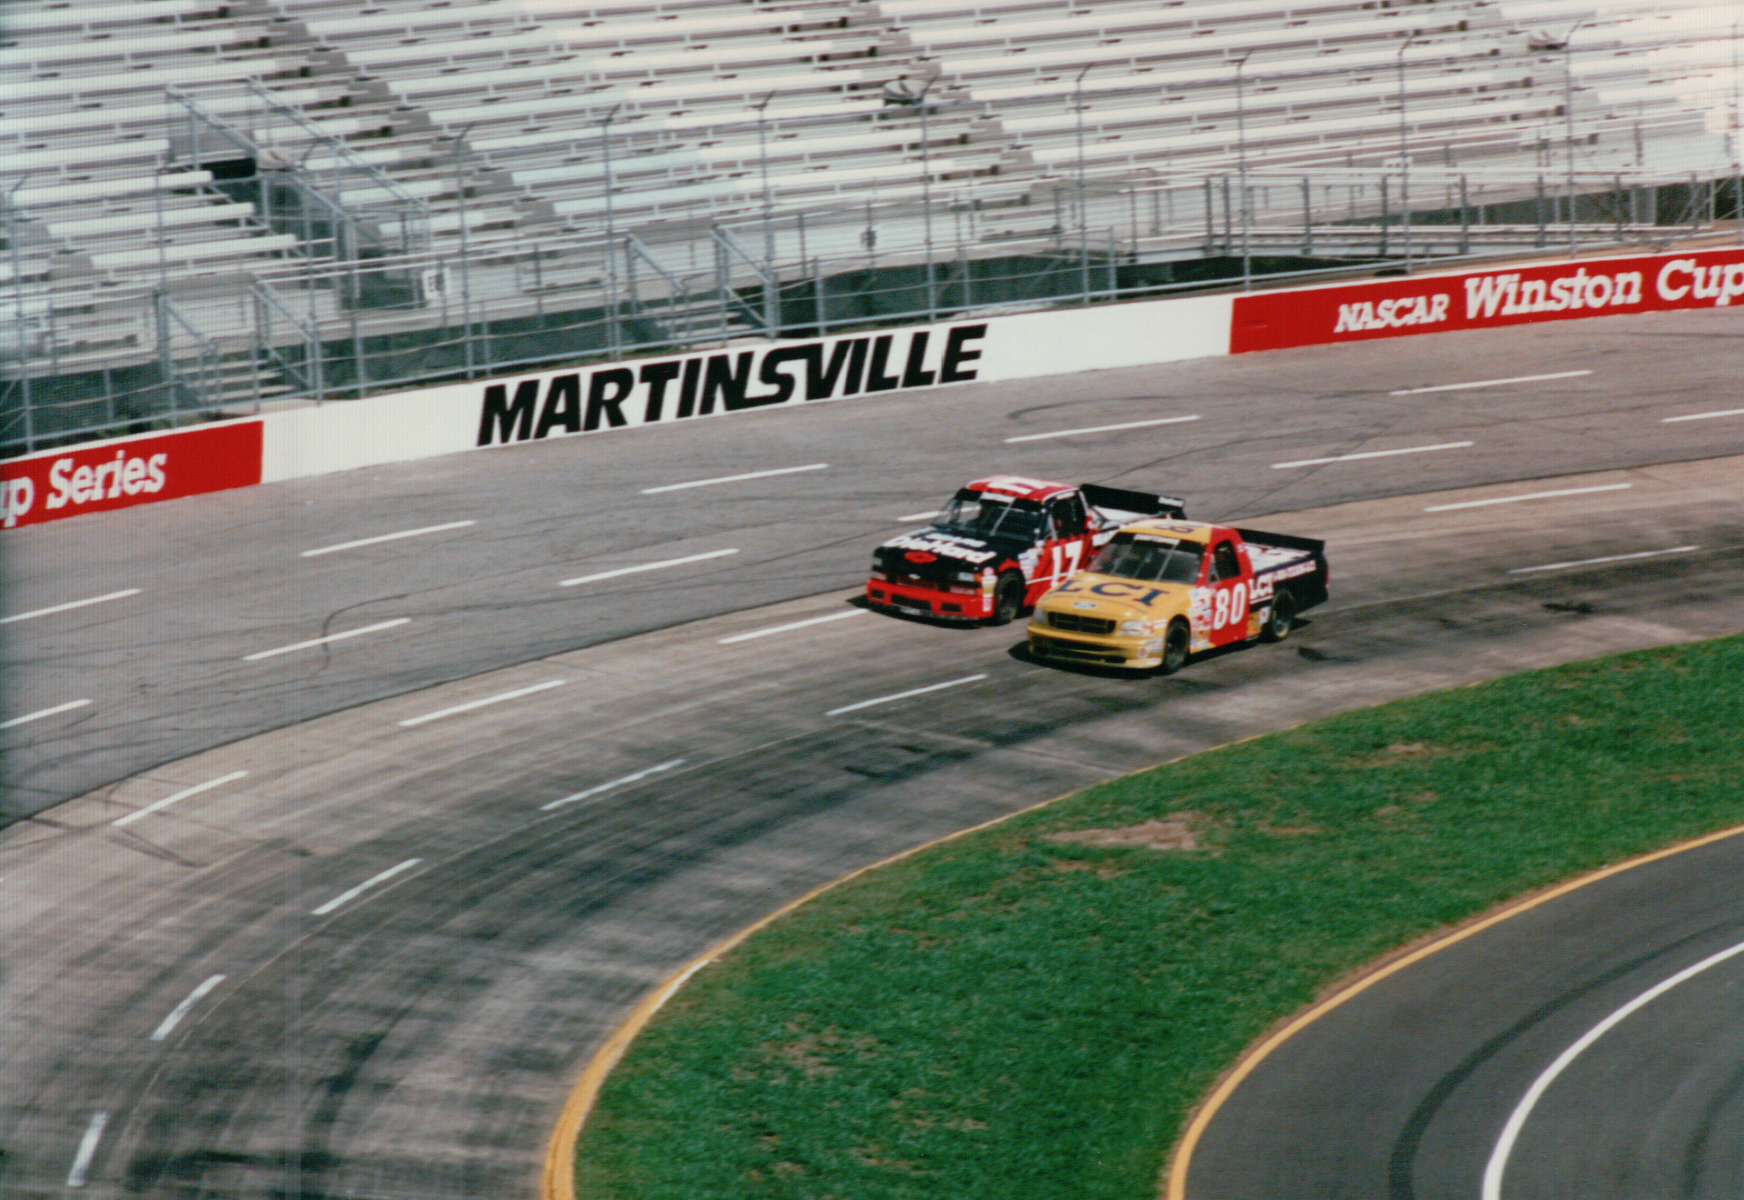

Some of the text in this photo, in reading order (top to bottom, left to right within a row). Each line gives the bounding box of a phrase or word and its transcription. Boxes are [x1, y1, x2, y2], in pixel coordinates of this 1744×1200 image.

[1334, 259, 1744, 334] NASCAR Winston Cup
[477, 323, 988, 447] MARTINSVILLE
[46, 449, 167, 510] Series
[1051, 540, 1083, 588] 17
[1056, 581, 1170, 607] LCI
[1213, 583, 1246, 630] 80
